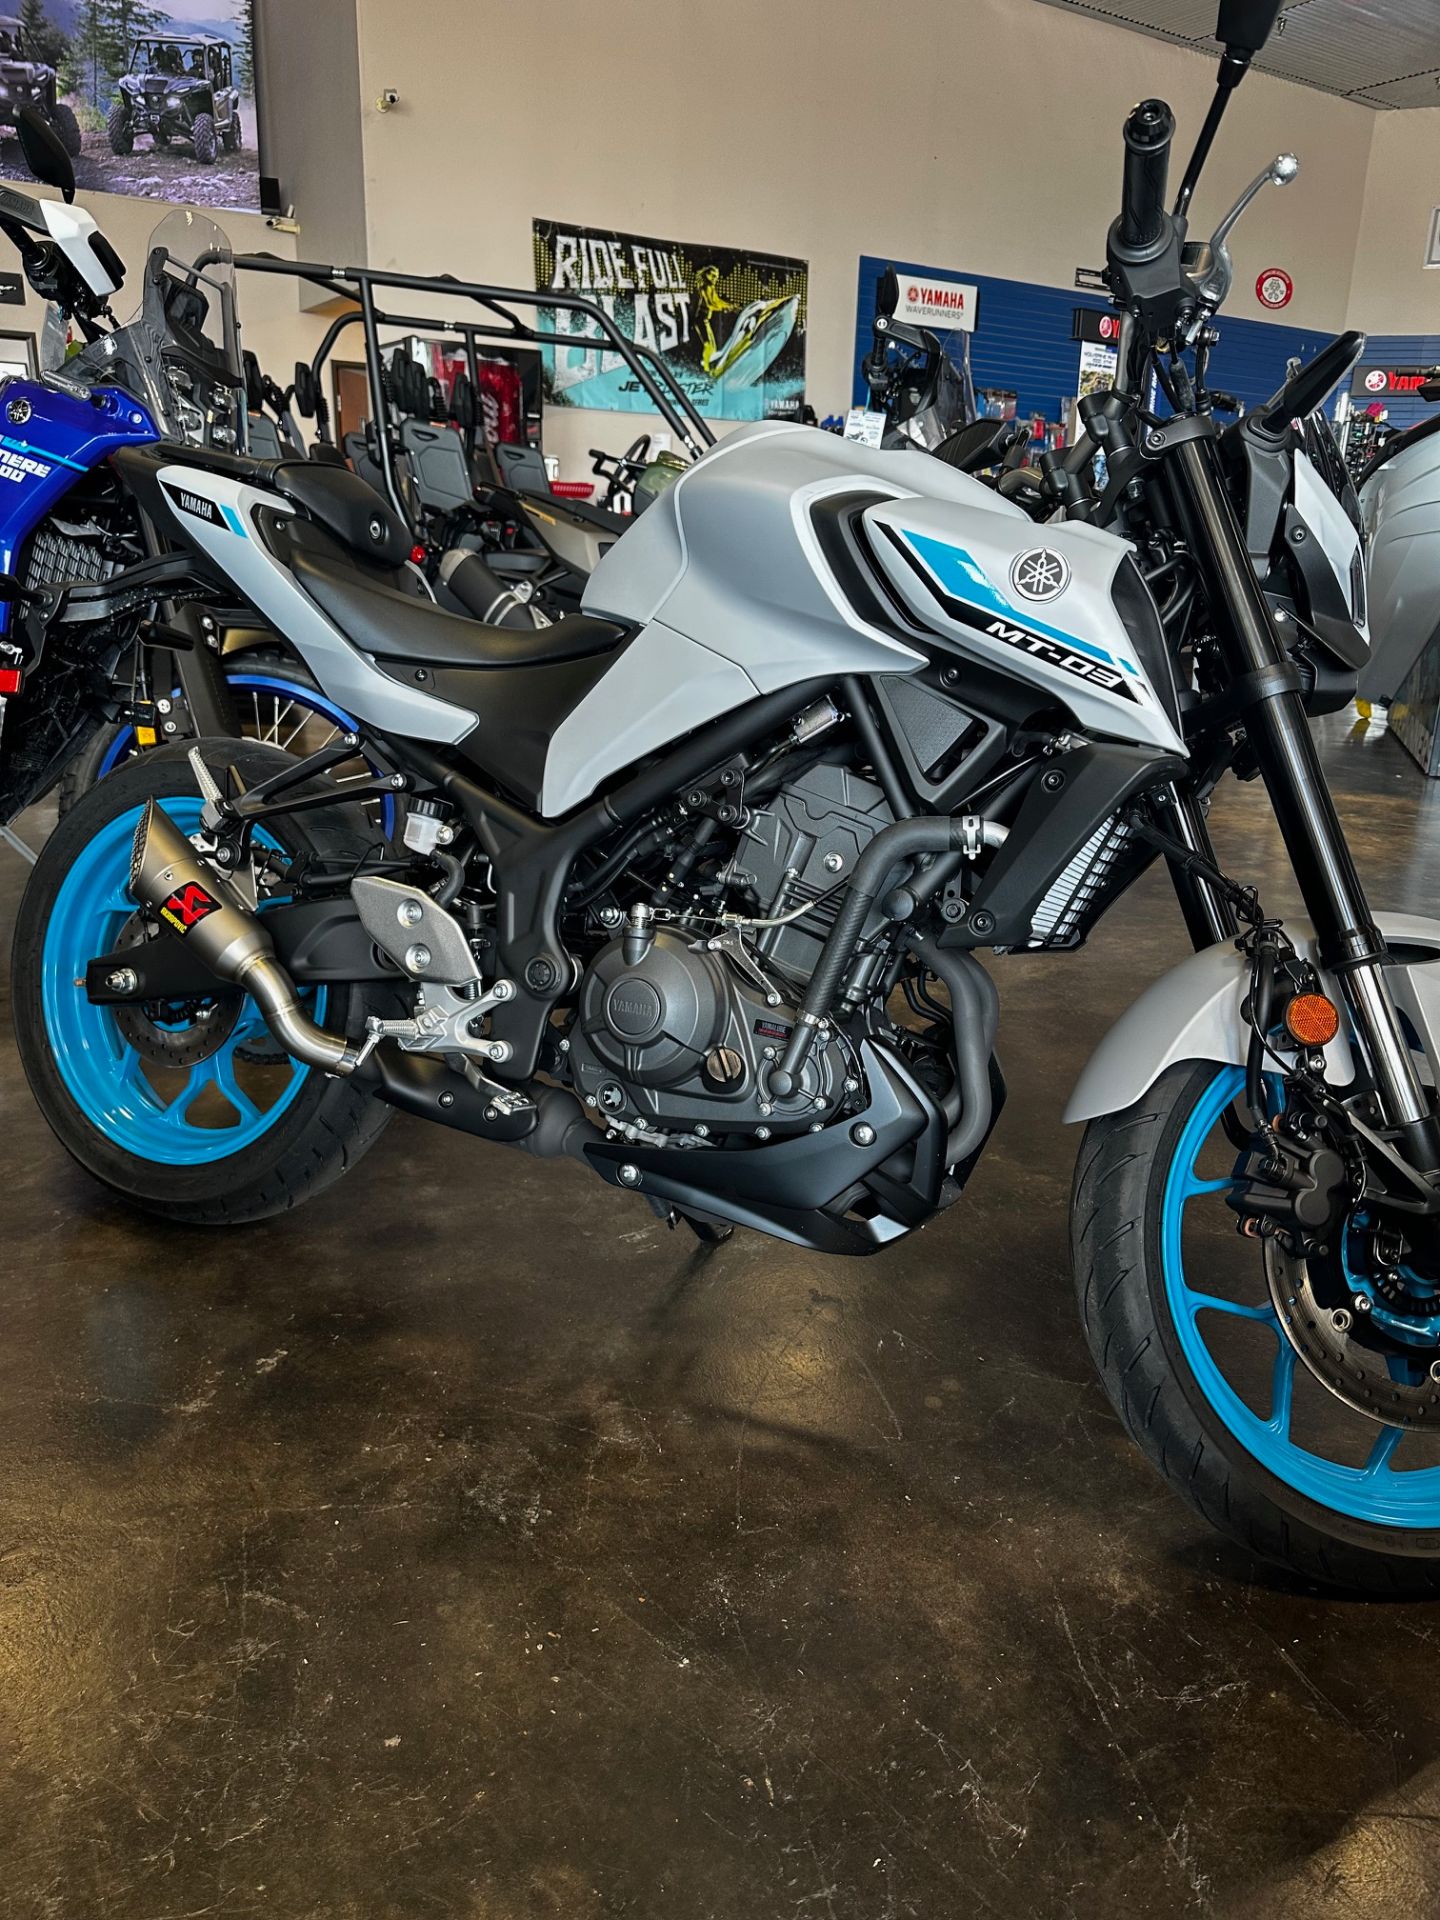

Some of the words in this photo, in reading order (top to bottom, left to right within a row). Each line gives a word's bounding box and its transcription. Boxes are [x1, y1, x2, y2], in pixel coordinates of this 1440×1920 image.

[551, 235, 635, 289] RIDE
[631, 245, 687, 288] FULL
[921, 288, 964, 309] YAMAHA
[551, 293, 690, 394] BLAST
[1387, 371, 1427, 391] YAM
[180, 491, 213, 519] YAMAHA
[985, 621, 1124, 689] MT-03
[612, 998, 653, 1016] YAMAHA
